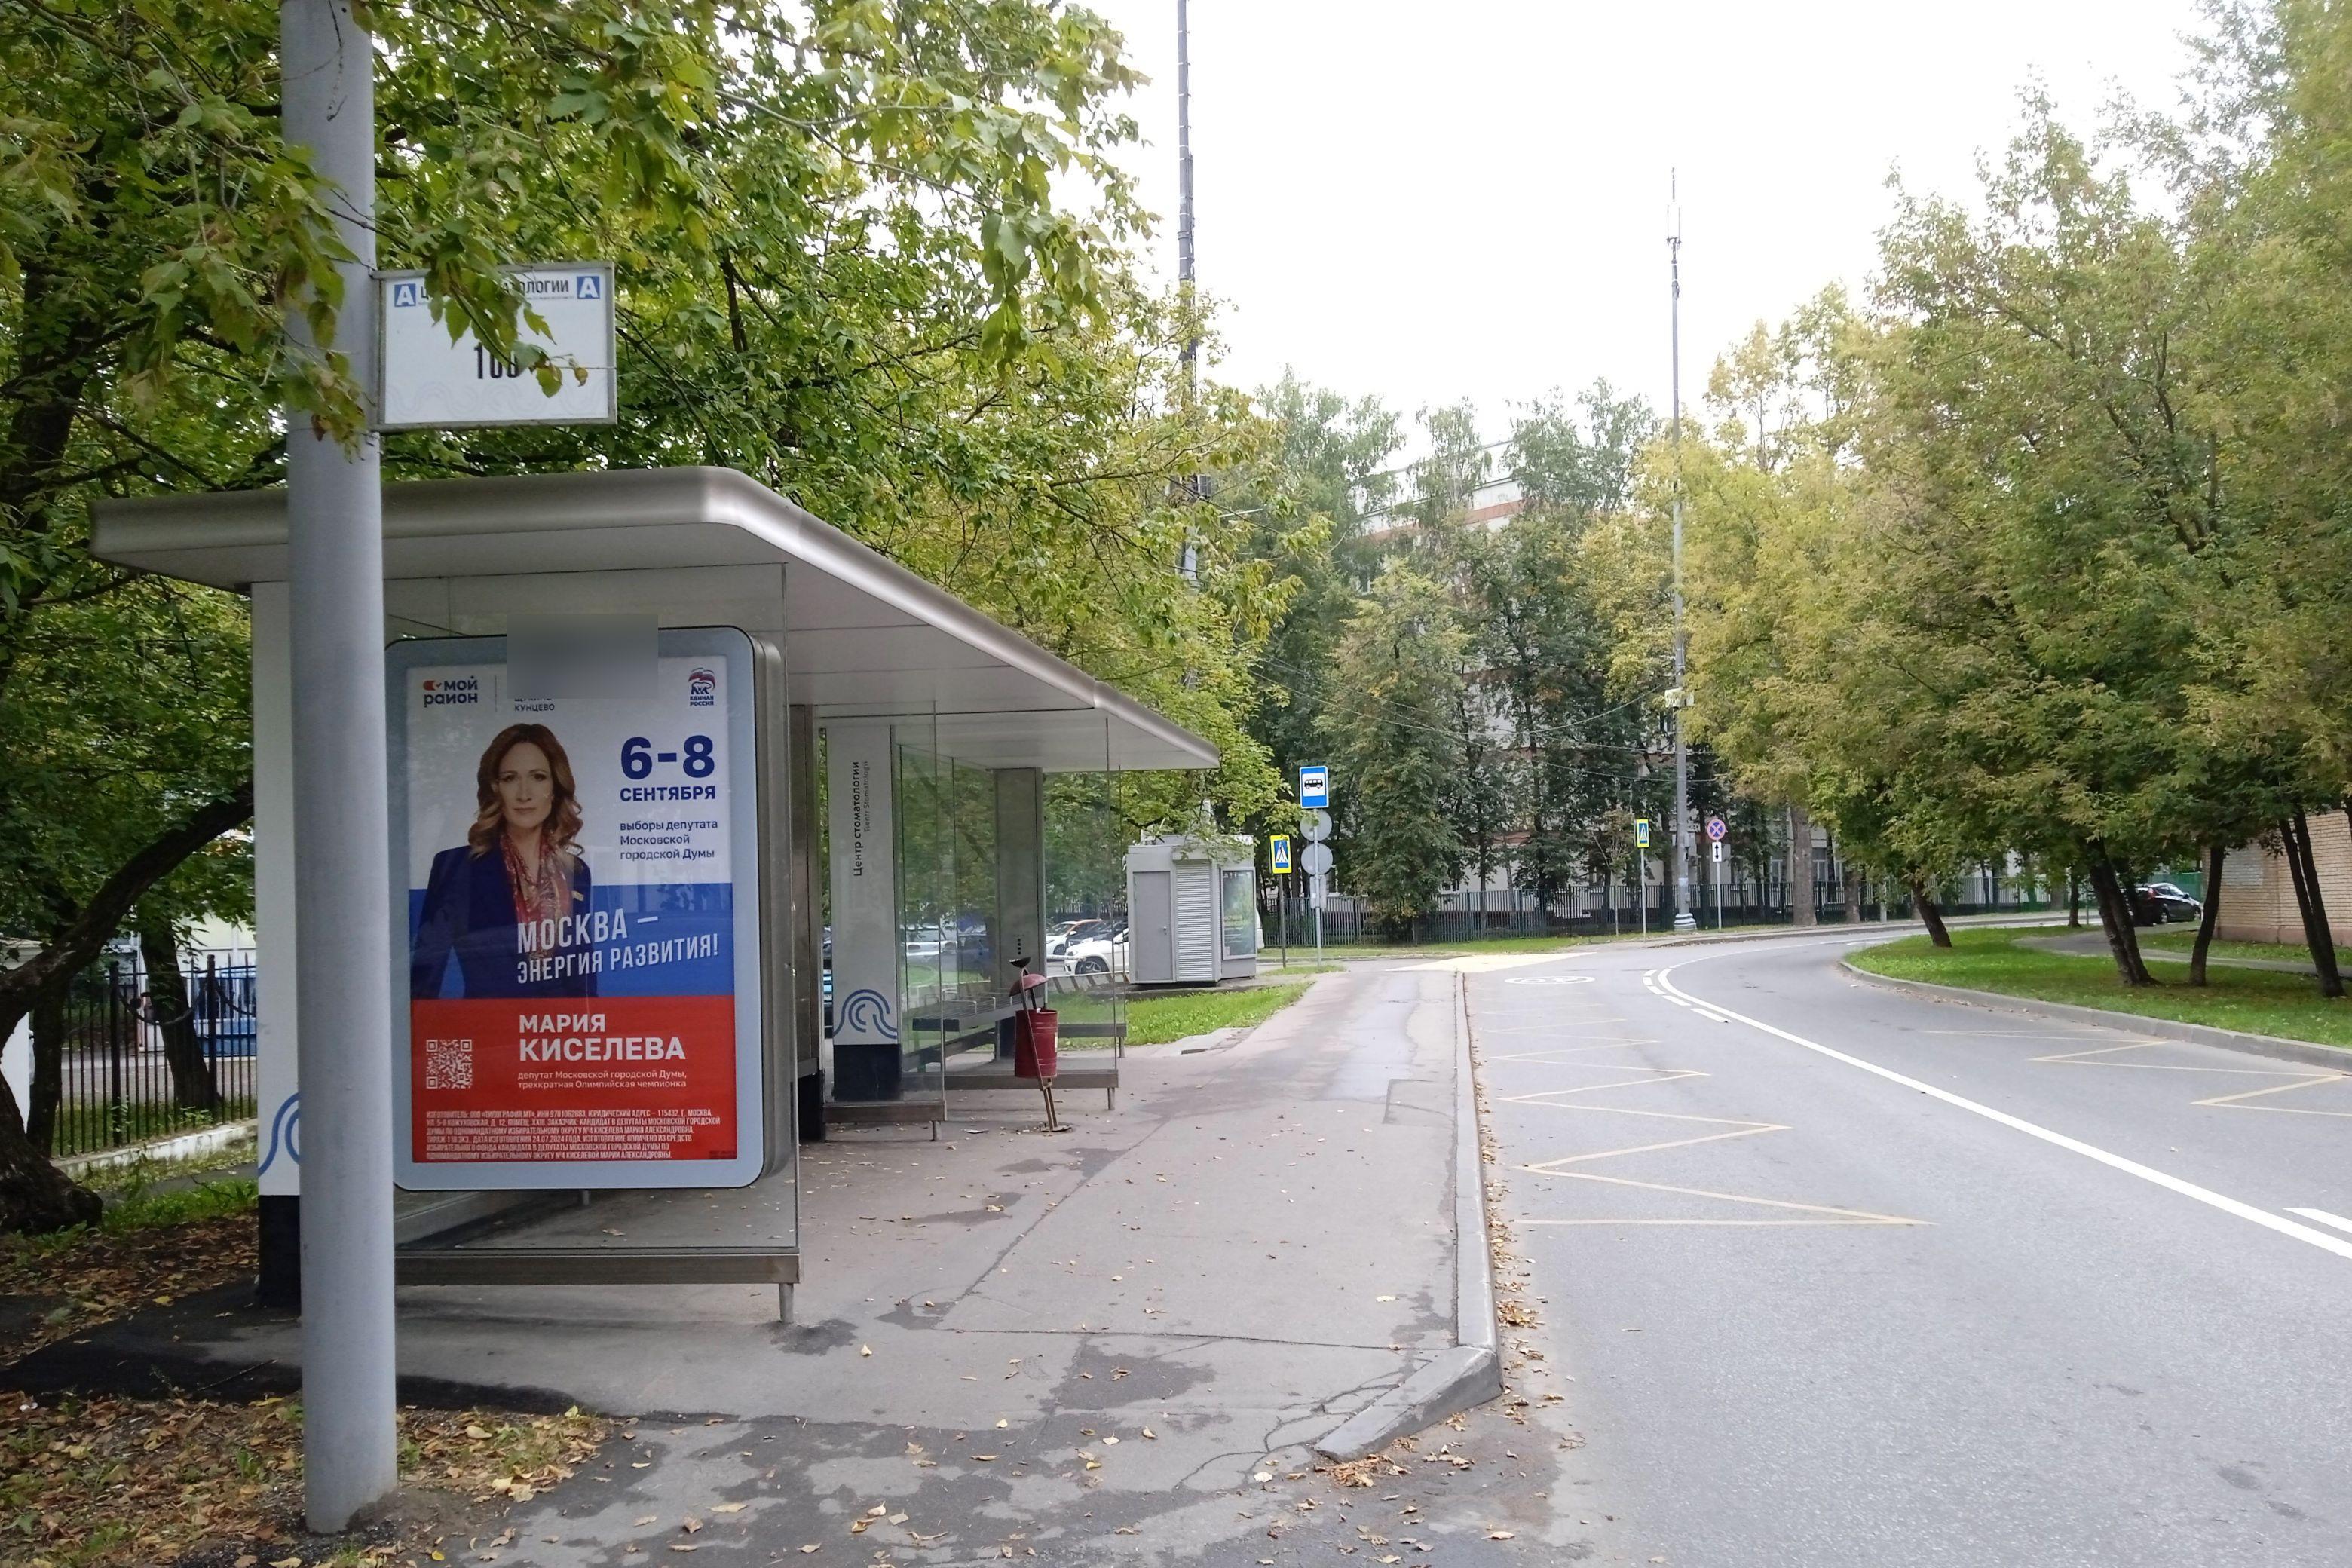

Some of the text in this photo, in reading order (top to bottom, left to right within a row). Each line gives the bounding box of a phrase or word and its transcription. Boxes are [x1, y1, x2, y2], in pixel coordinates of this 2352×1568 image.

[444, 675, 478, 691] мой
[514, 703, 555, 712] КУНЦЕВО
[620, 786, 715, 801] СЕНТЯБРЯ
[620, 820, 718, 832] выборы депутата
[853, 761, 863, 877] Центр стоматологии
[620, 834, 690, 845] Московской
[620, 849, 715, 861] городской Думы
[517, 908, 628, 954] МОСКВА
[517, 933, 718, 984] ЭНЕРГИЯ РАЗВИТИЯ!
[519, 1014, 605, 1033] МАРИЯ
[519, 1037, 686, 1061] КИСЕЛЕВА
[518, 1070, 687, 1080] депутат Московской городской Думы,
[518, 1082, 574, 1090] трехкратная
